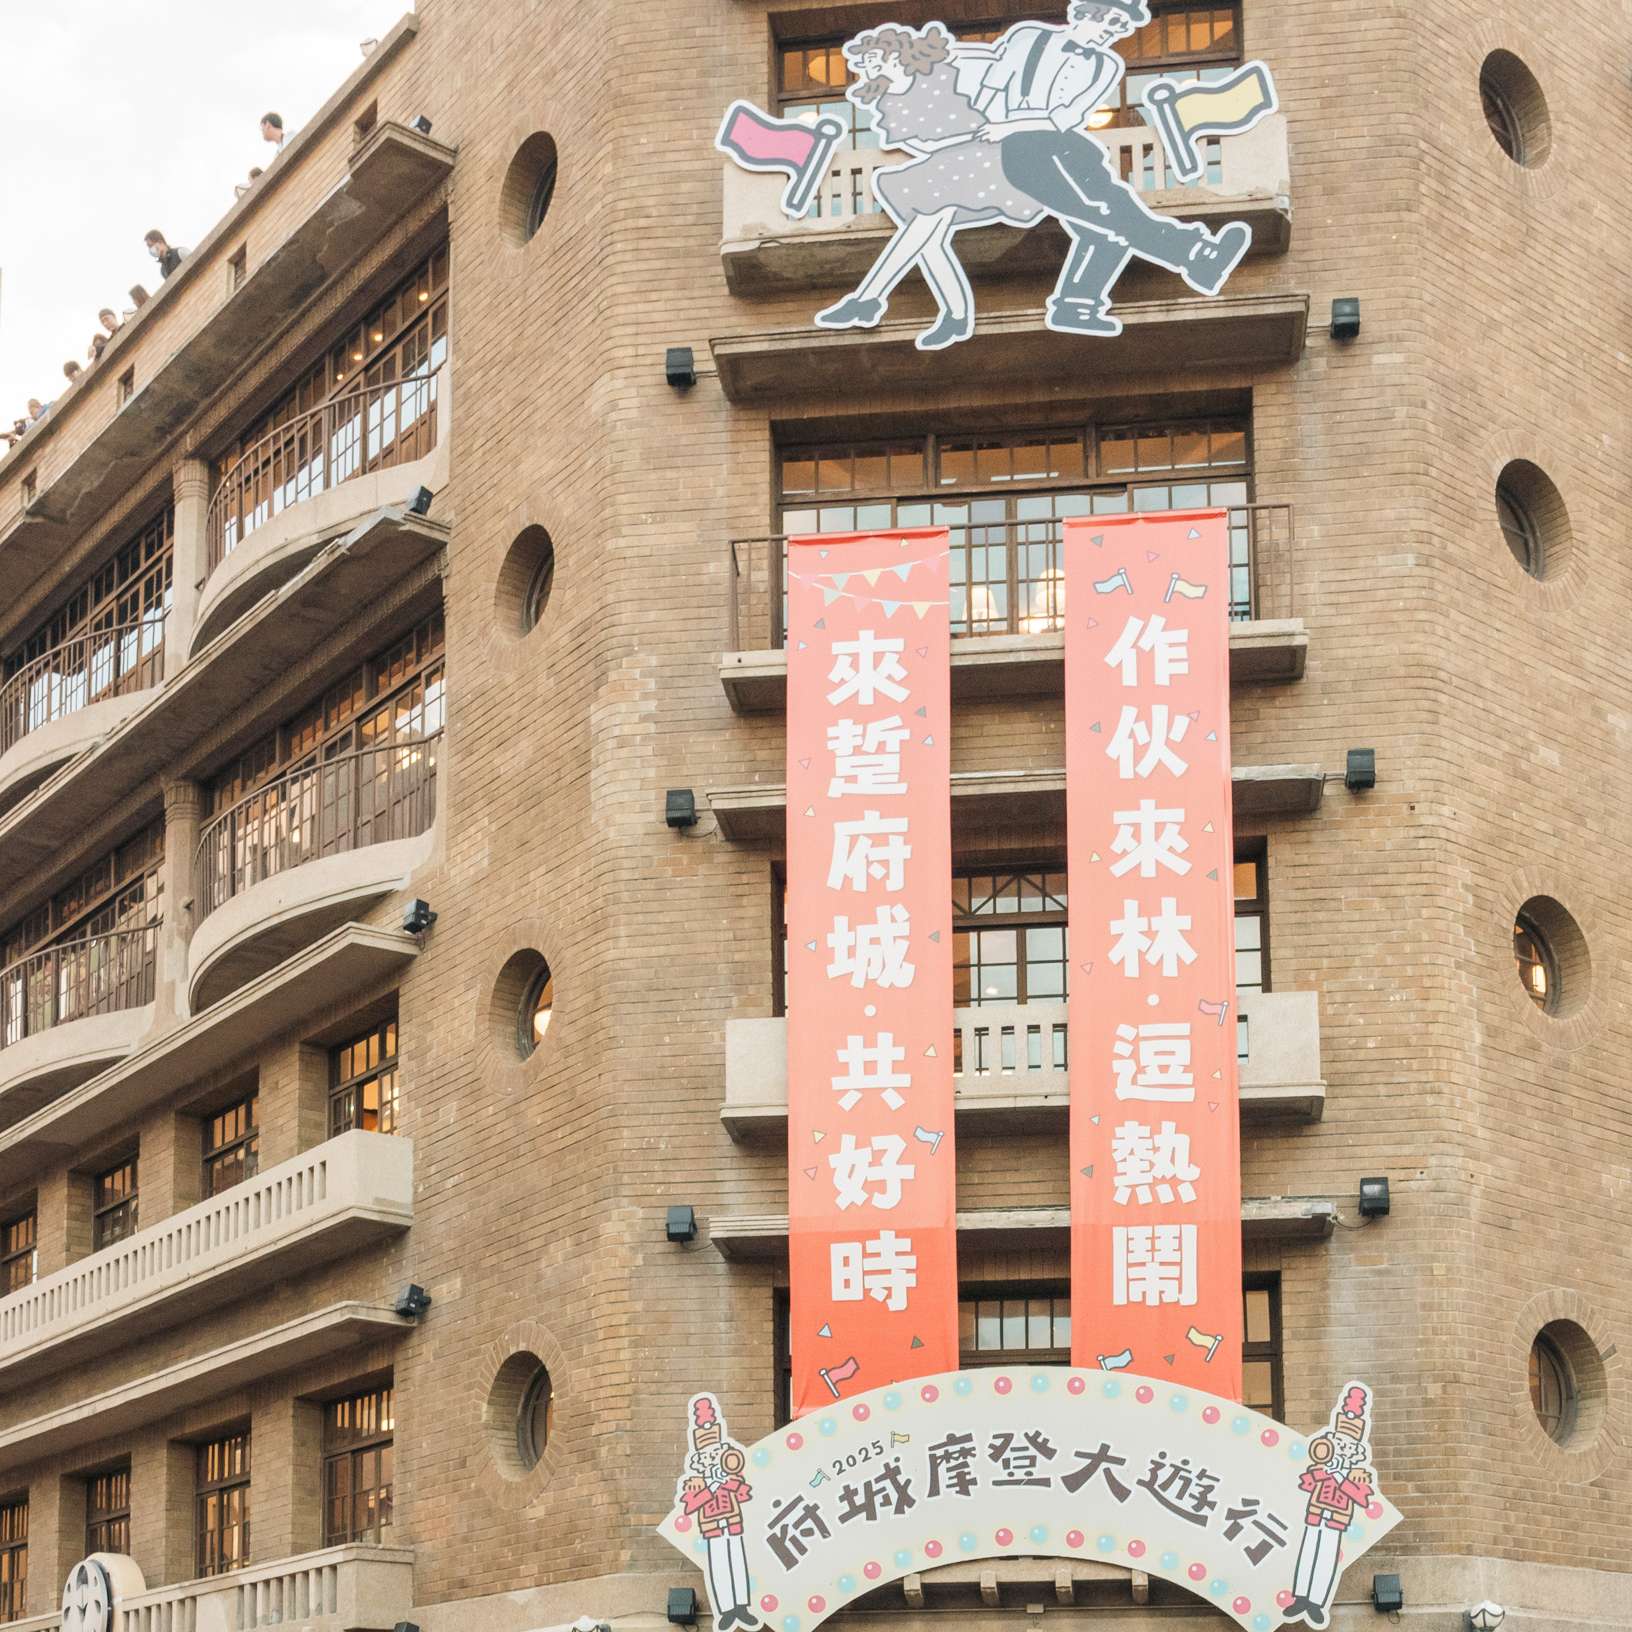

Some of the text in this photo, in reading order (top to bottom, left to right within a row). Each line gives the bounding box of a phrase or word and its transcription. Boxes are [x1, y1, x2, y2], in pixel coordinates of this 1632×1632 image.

[764, 1430, 1293, 1573] 府城摩登大遊行
[833, 1440, 885, 1477] 2025
